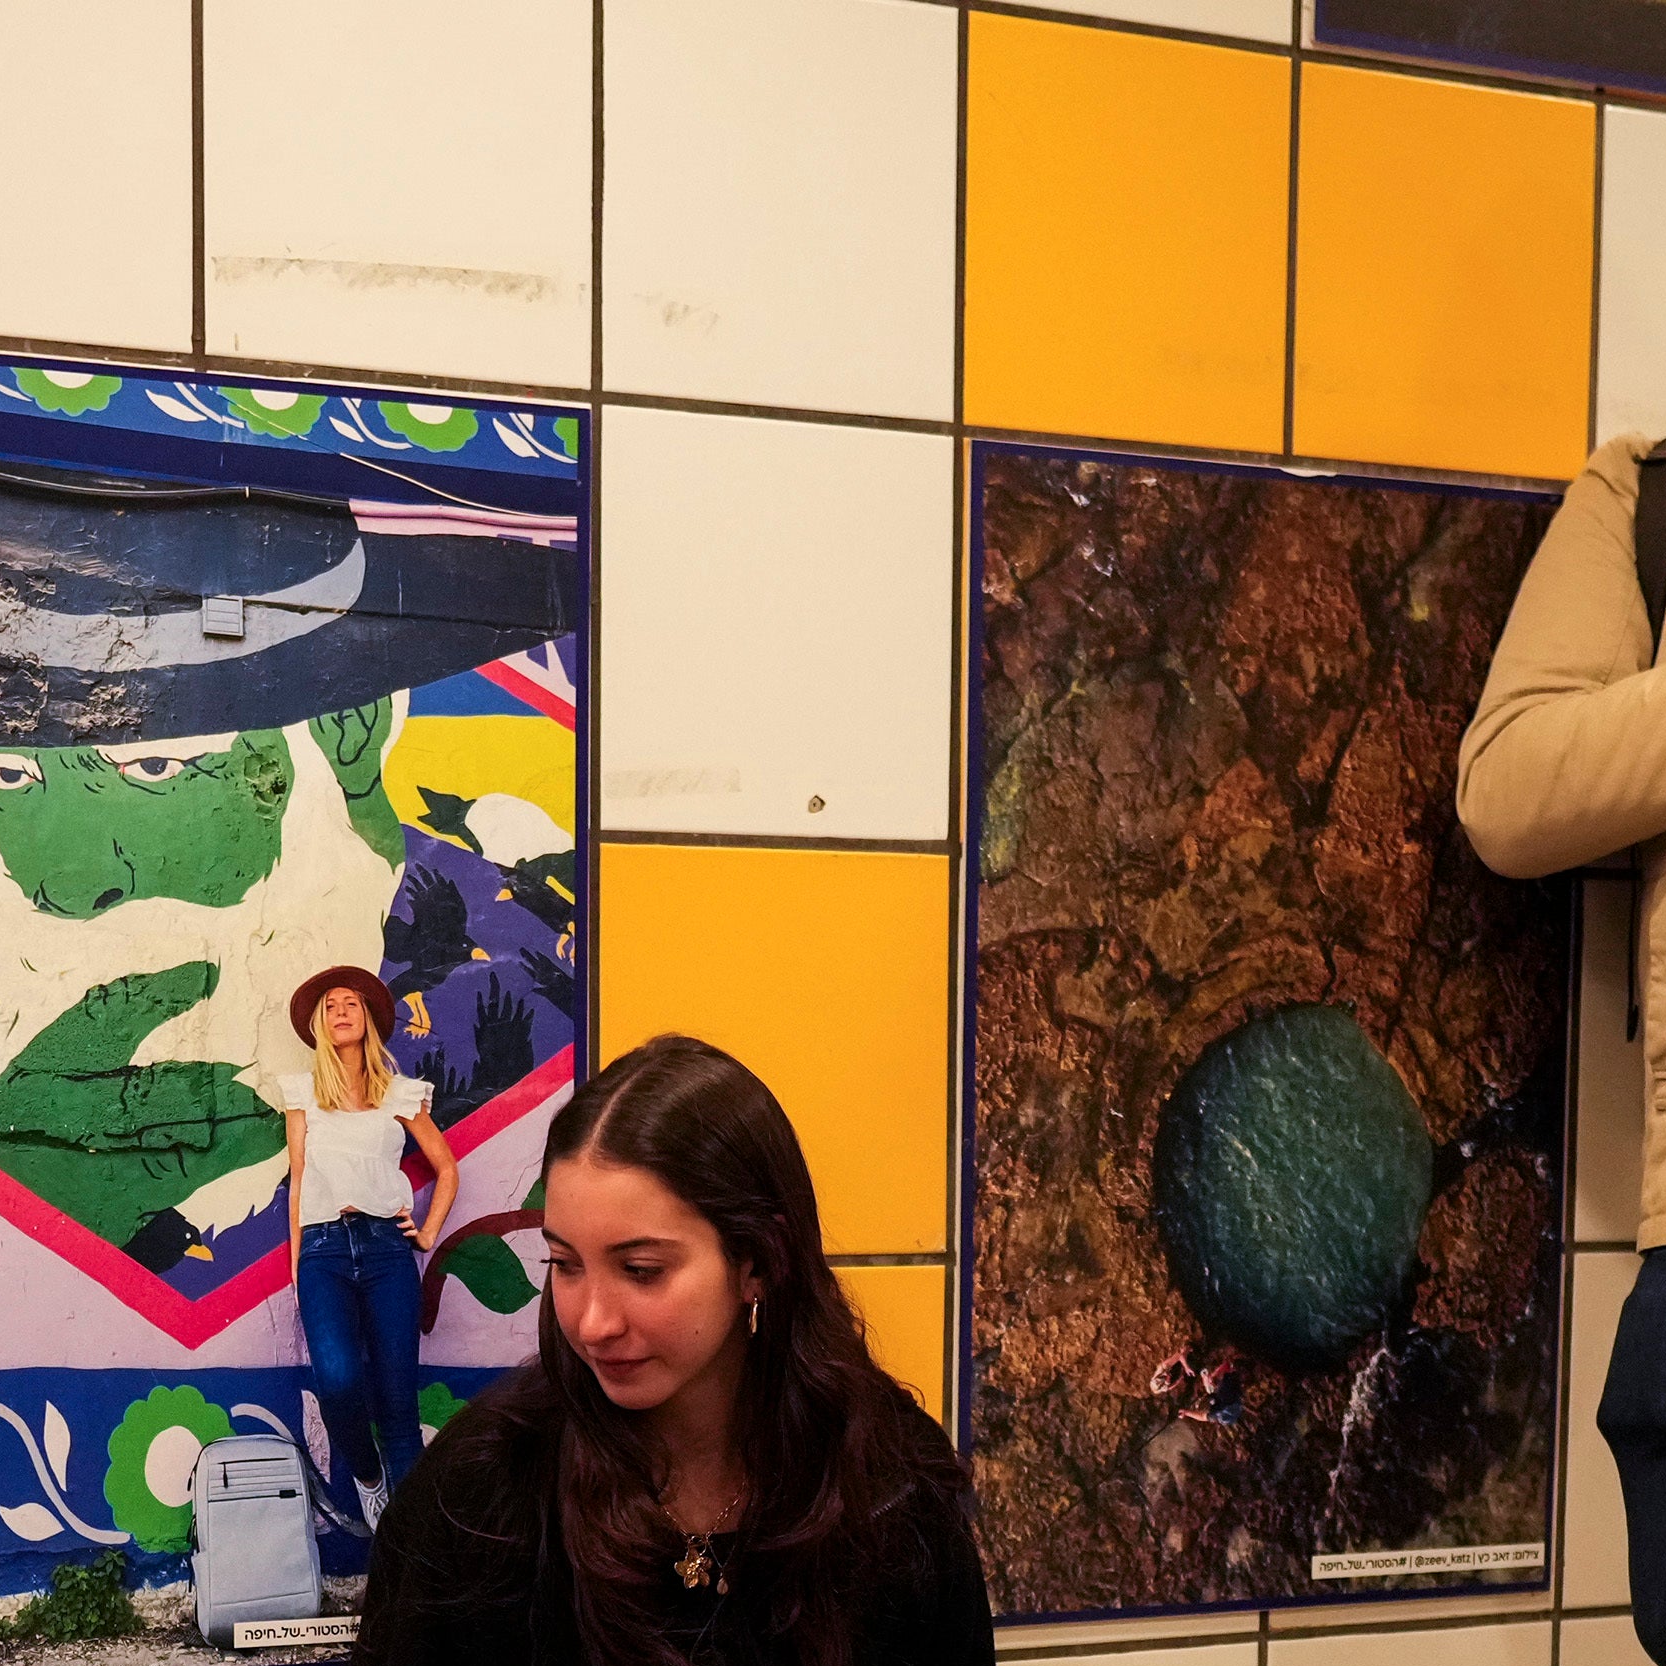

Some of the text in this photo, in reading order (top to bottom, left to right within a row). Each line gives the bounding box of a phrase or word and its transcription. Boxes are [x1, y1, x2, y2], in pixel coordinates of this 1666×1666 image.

[1414, 1552, 1471, 1568] @zeev_katz
[1512, 1549, 1539, 1561] צילום:
[1319, 1556, 1407, 1573] #הסטורי_של_חיפה
[244, 1622, 360, 1641] #הסטורי_של_חיפה
